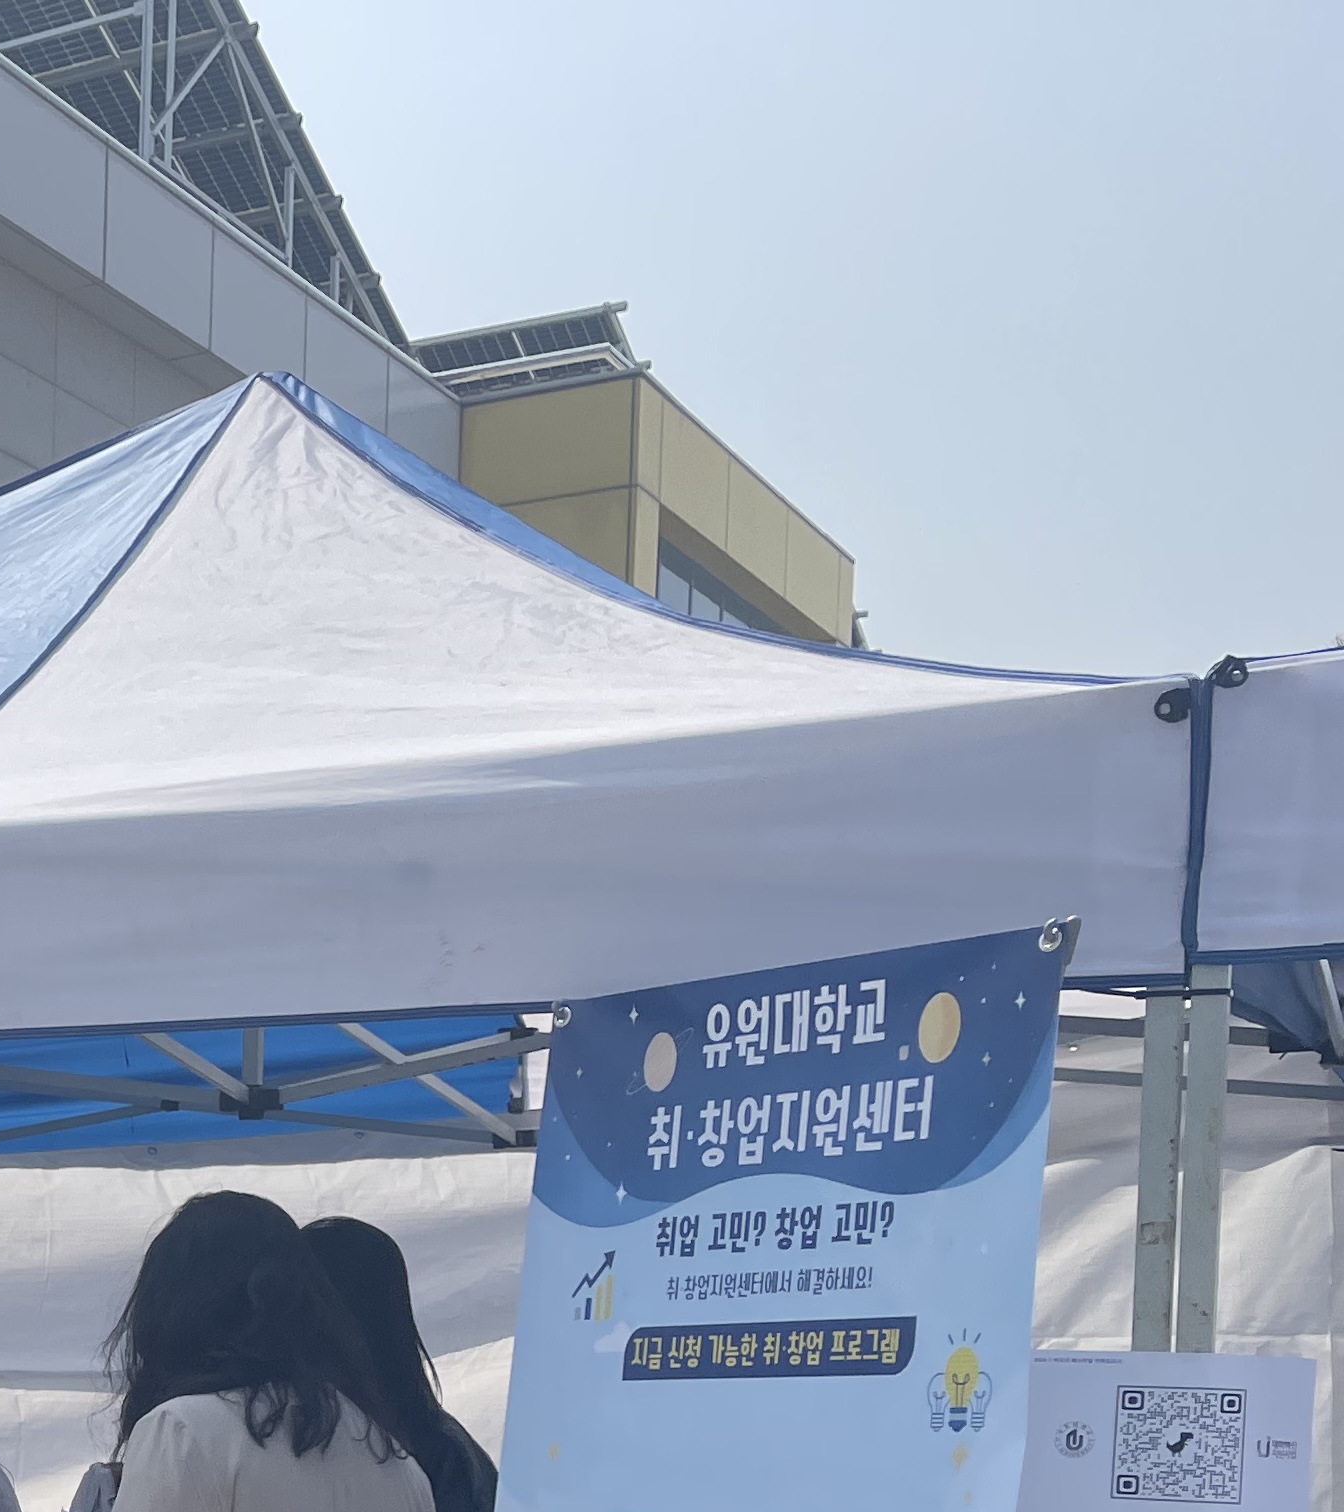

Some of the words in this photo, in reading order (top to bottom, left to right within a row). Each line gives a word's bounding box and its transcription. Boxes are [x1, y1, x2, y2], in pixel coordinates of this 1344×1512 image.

[701, 978, 888, 1069] 유원대학교
[646, 1075, 935, 1171] 취·창업지원센터
[656, 1215, 700, 1258] 취업
[707, 1209, 767, 1254] 고민?
[775, 1206, 823, 1251] 창업
[831, 1200, 896, 1245] 고민?
[796, 1266, 874, 1295] 해결하세요!
[631, 1336, 663, 1371] 지금
[668, 1332, 703, 1368] 신청
[709, 1331, 759, 1367] 가능한
[763, 1331, 825, 1366] 취·창업
[830, 1328, 901, 1364] 프로그램
